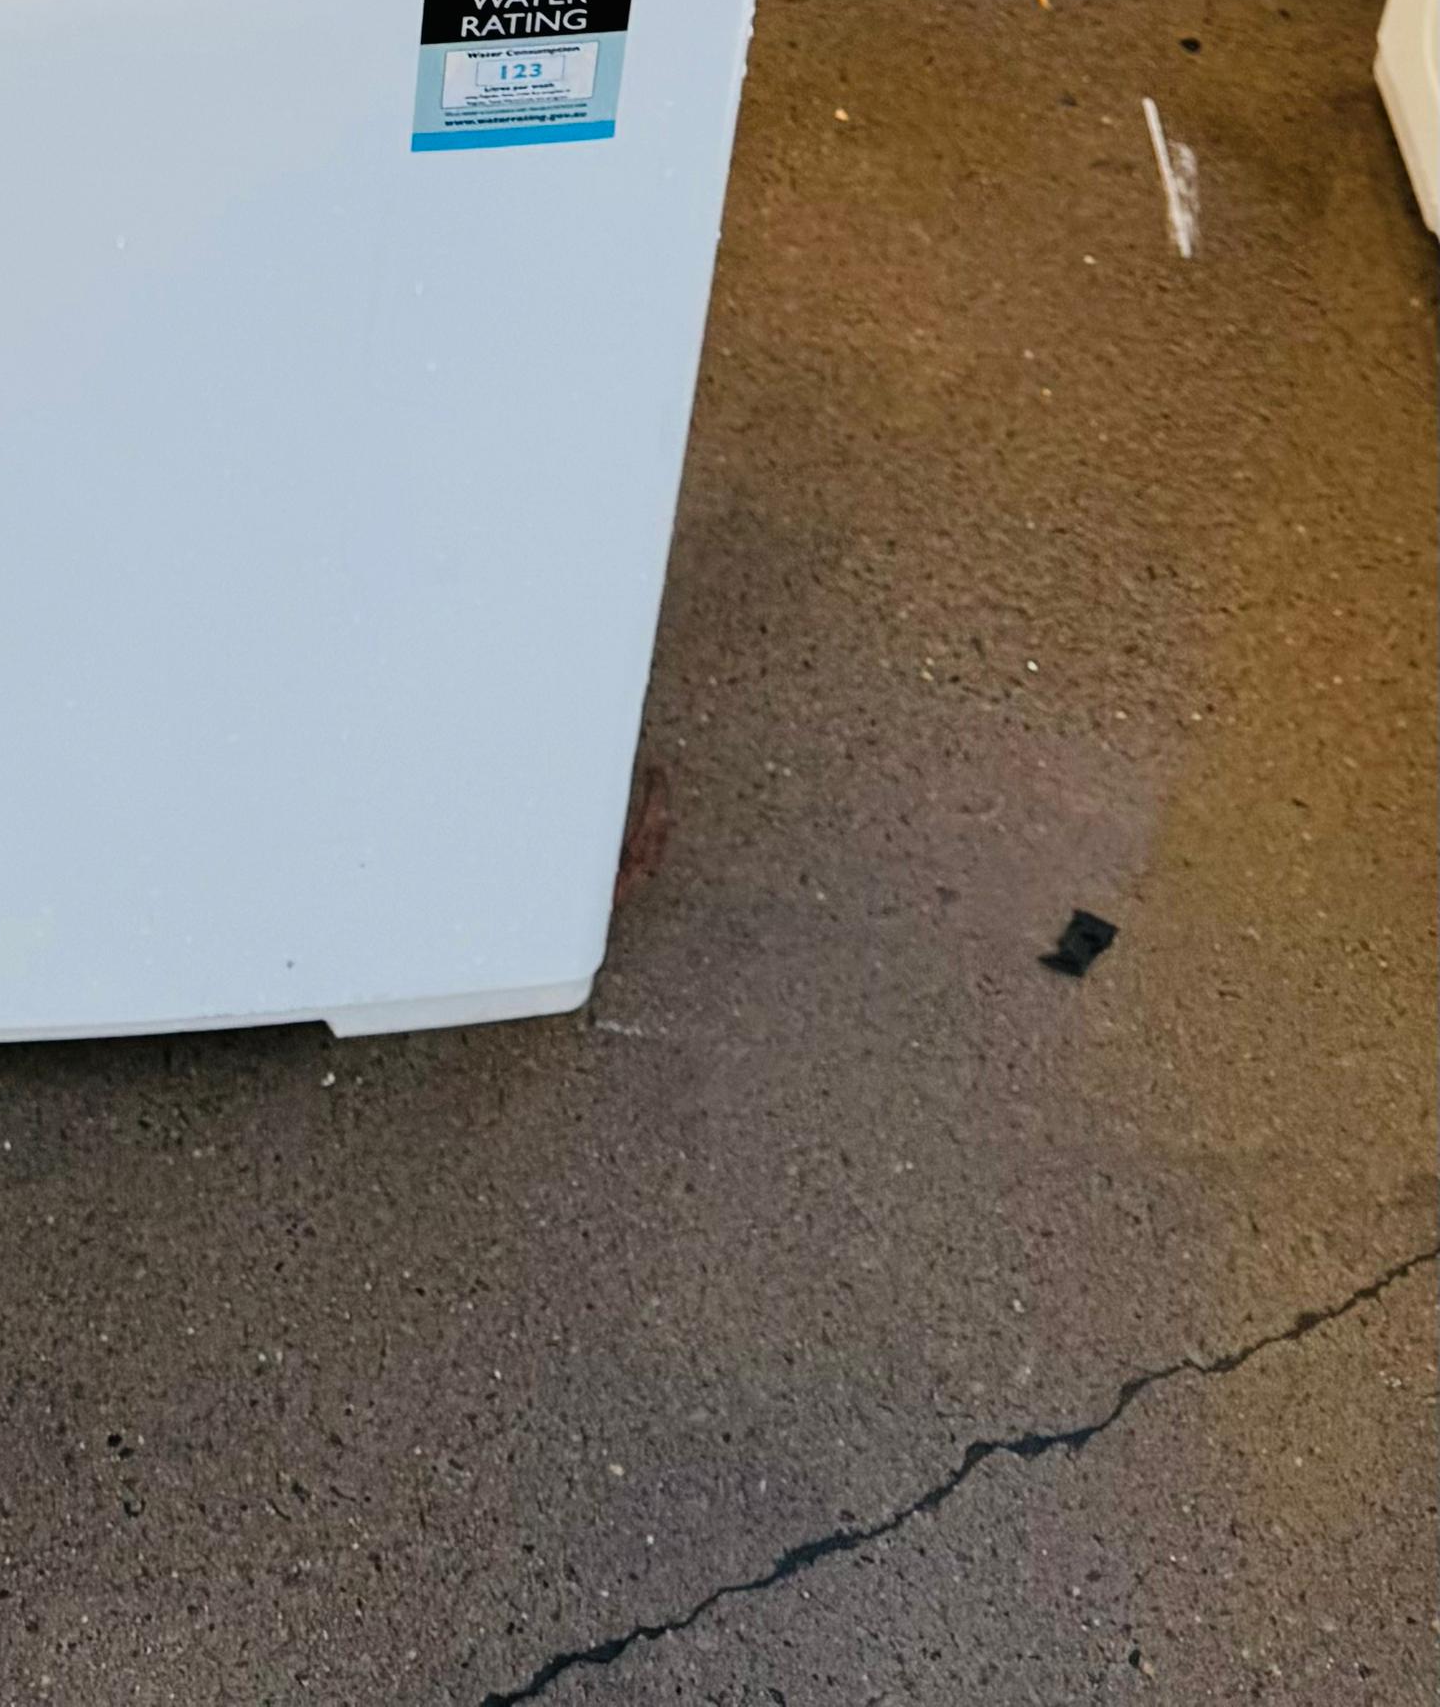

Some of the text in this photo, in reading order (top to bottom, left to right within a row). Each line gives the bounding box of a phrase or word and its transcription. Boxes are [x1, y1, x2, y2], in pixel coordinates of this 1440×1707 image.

[461, 8, 588, 38] RATING
[467, 46, 581, 59] Water Consumption
[500, 63, 542, 80] 123
